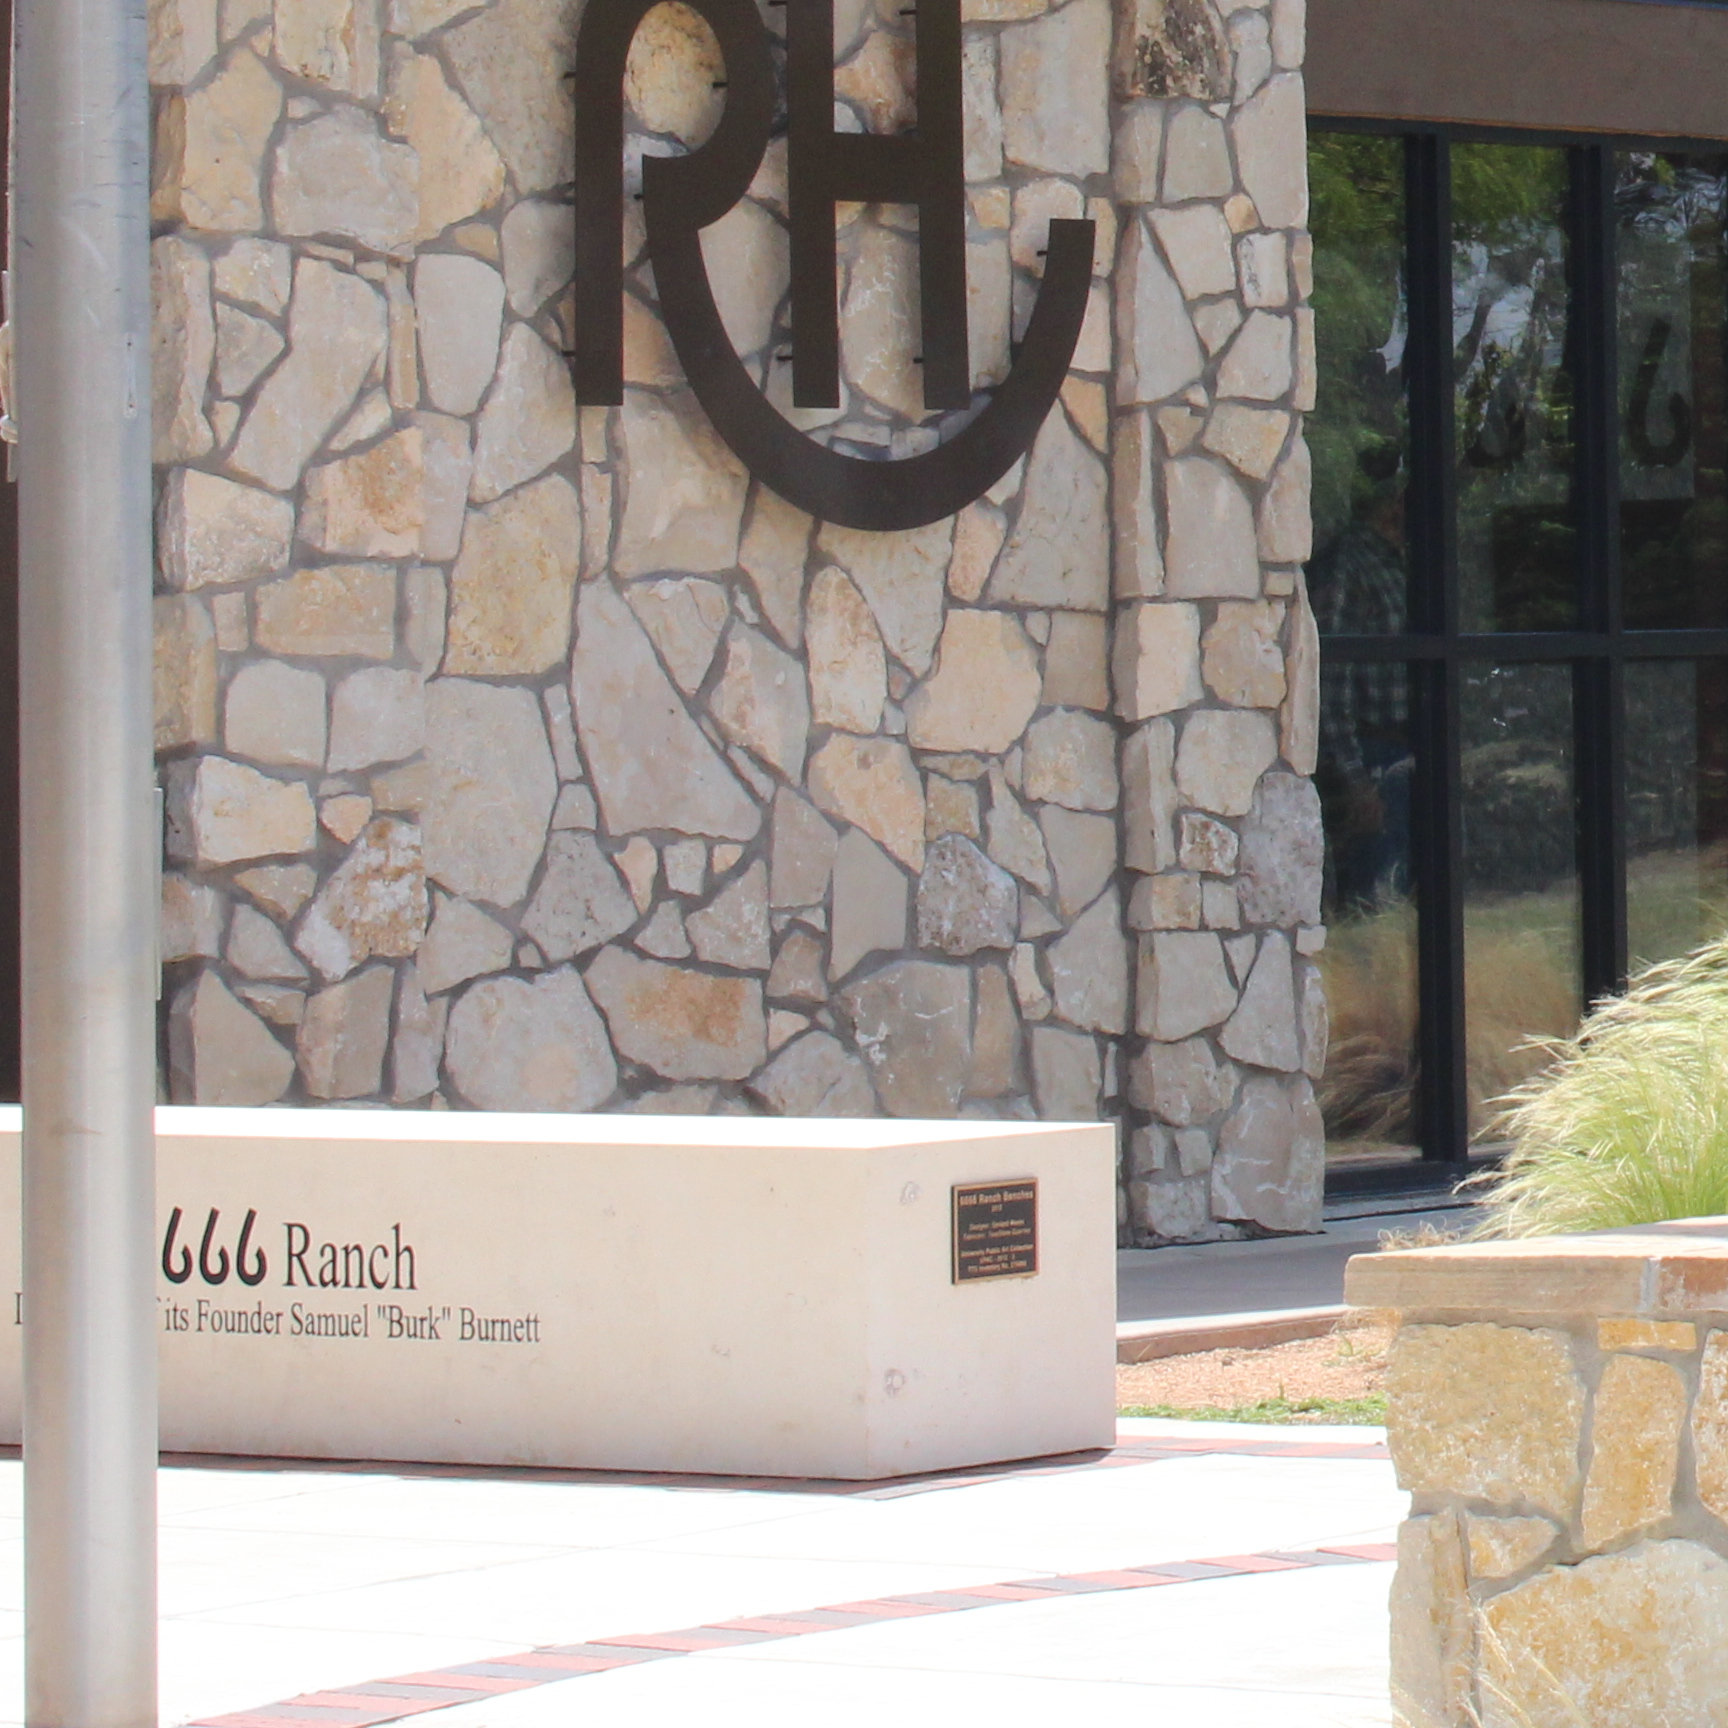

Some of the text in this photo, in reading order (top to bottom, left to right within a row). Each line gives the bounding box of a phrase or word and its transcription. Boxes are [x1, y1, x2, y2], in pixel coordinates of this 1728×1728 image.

[979, 1192, 1001, 1204] Ranch
[282, 1222, 417, 1289] Ranch
[164, 1298, 189, 1331] its
[196, 1299, 284, 1334] Founder
[290, 1302, 370, 1337] Samuel
[377, 1305, 451, 1340] "Burk"
[458, 1307, 541, 1343] Burnett
